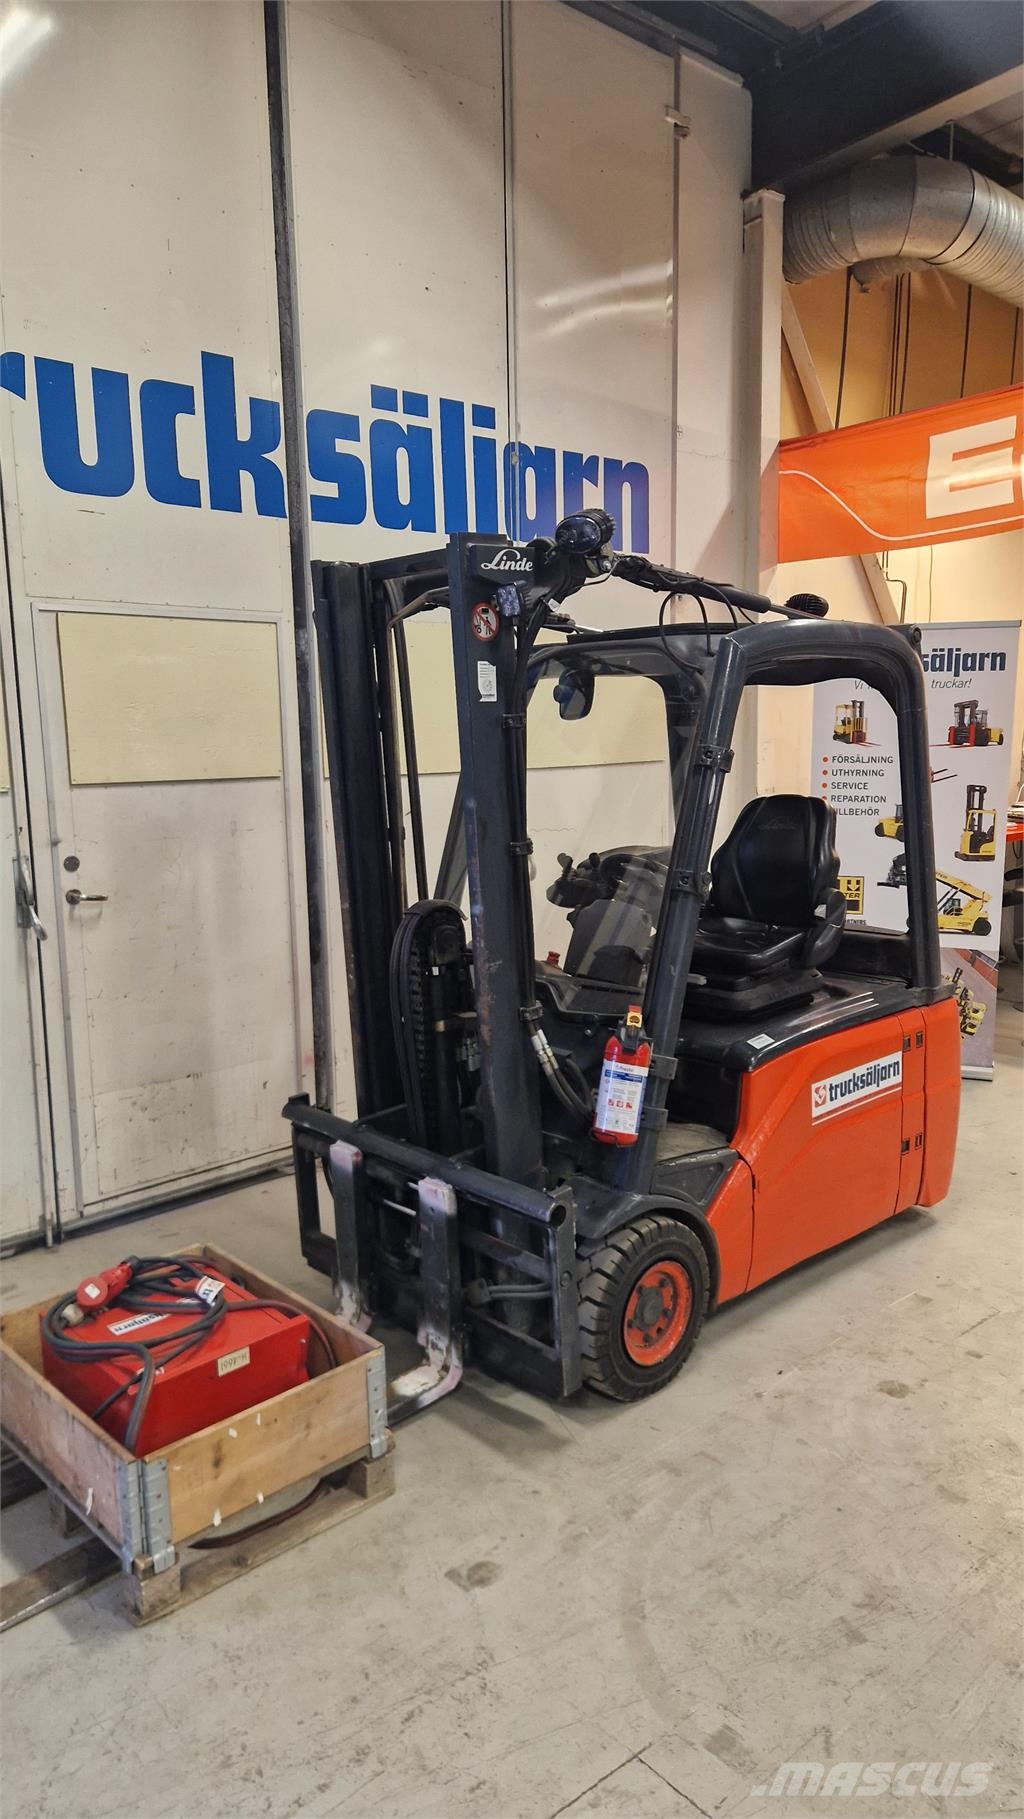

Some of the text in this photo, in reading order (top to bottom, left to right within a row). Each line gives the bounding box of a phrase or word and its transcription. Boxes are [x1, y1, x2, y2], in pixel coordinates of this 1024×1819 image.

[481, 549, 533, 571] Linde
[931, 679, 972, 689] truckar!
[831, 769, 885, 777] UTHYRNING
[831, 782, 869, 790] SERVICE
[831, 795, 887, 803] REPARATION
[829, 1060, 900, 1102] trucksäljarn
